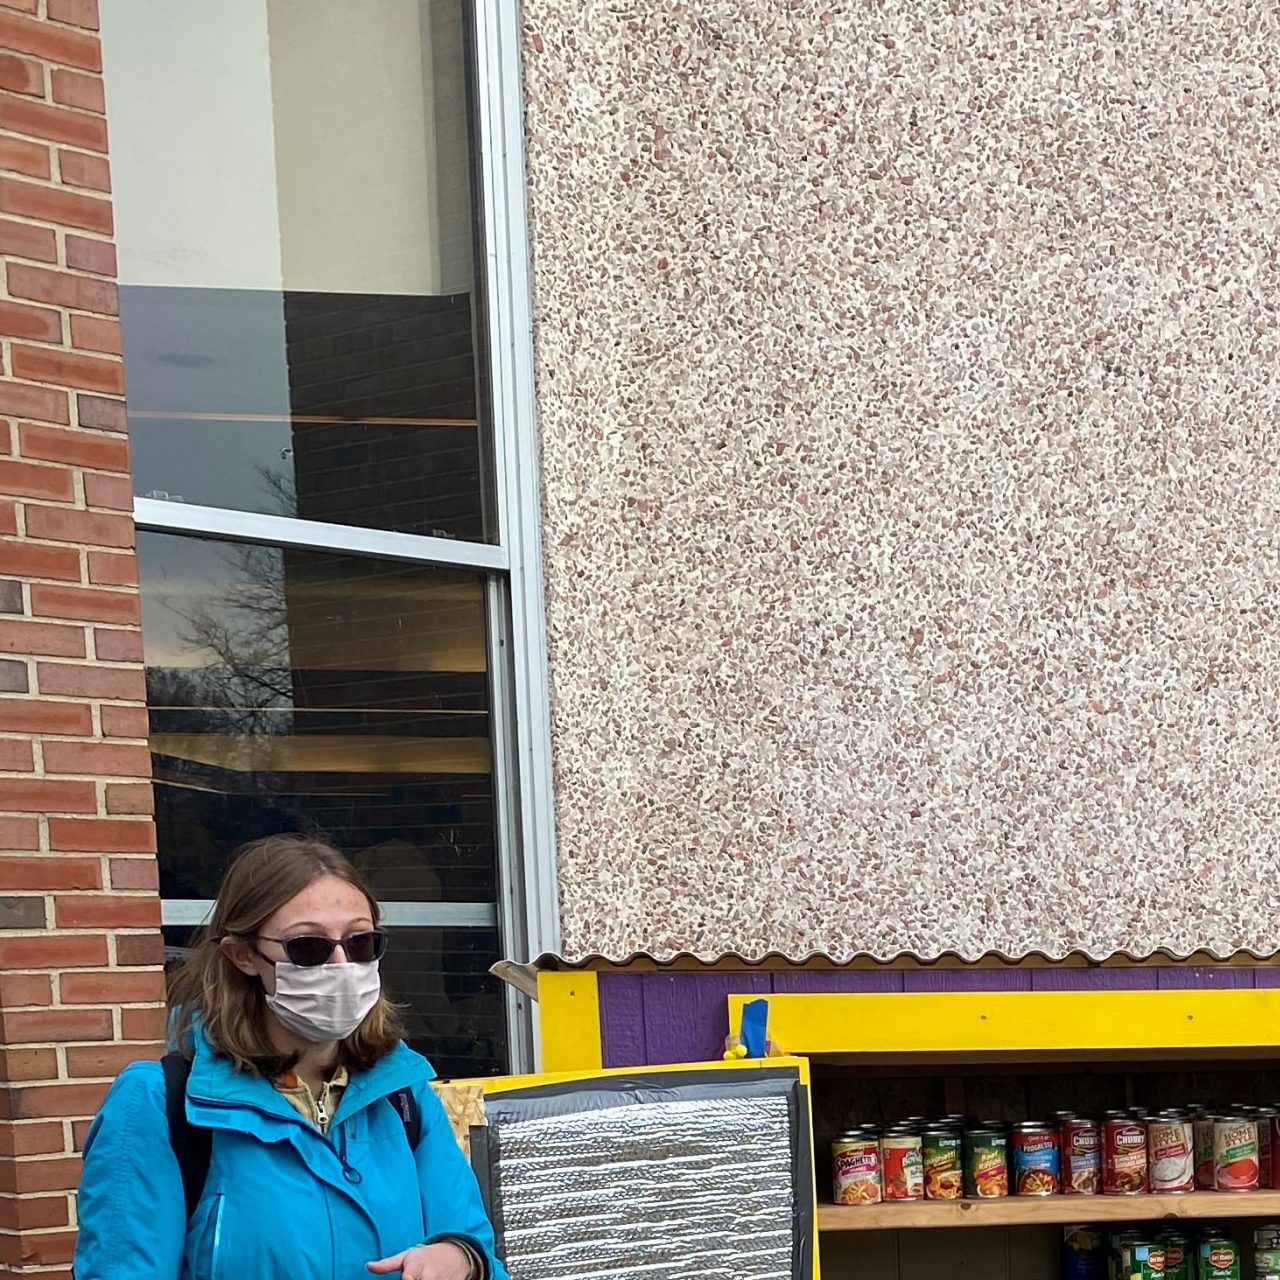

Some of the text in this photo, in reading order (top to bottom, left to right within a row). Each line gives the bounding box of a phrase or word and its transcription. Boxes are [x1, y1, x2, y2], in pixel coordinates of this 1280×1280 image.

[1224, 1127, 1252, 1140] HOME
[1116, 1134, 1145, 1146] CHUNKY
[1225, 1135, 1254, 1147] STYLE
